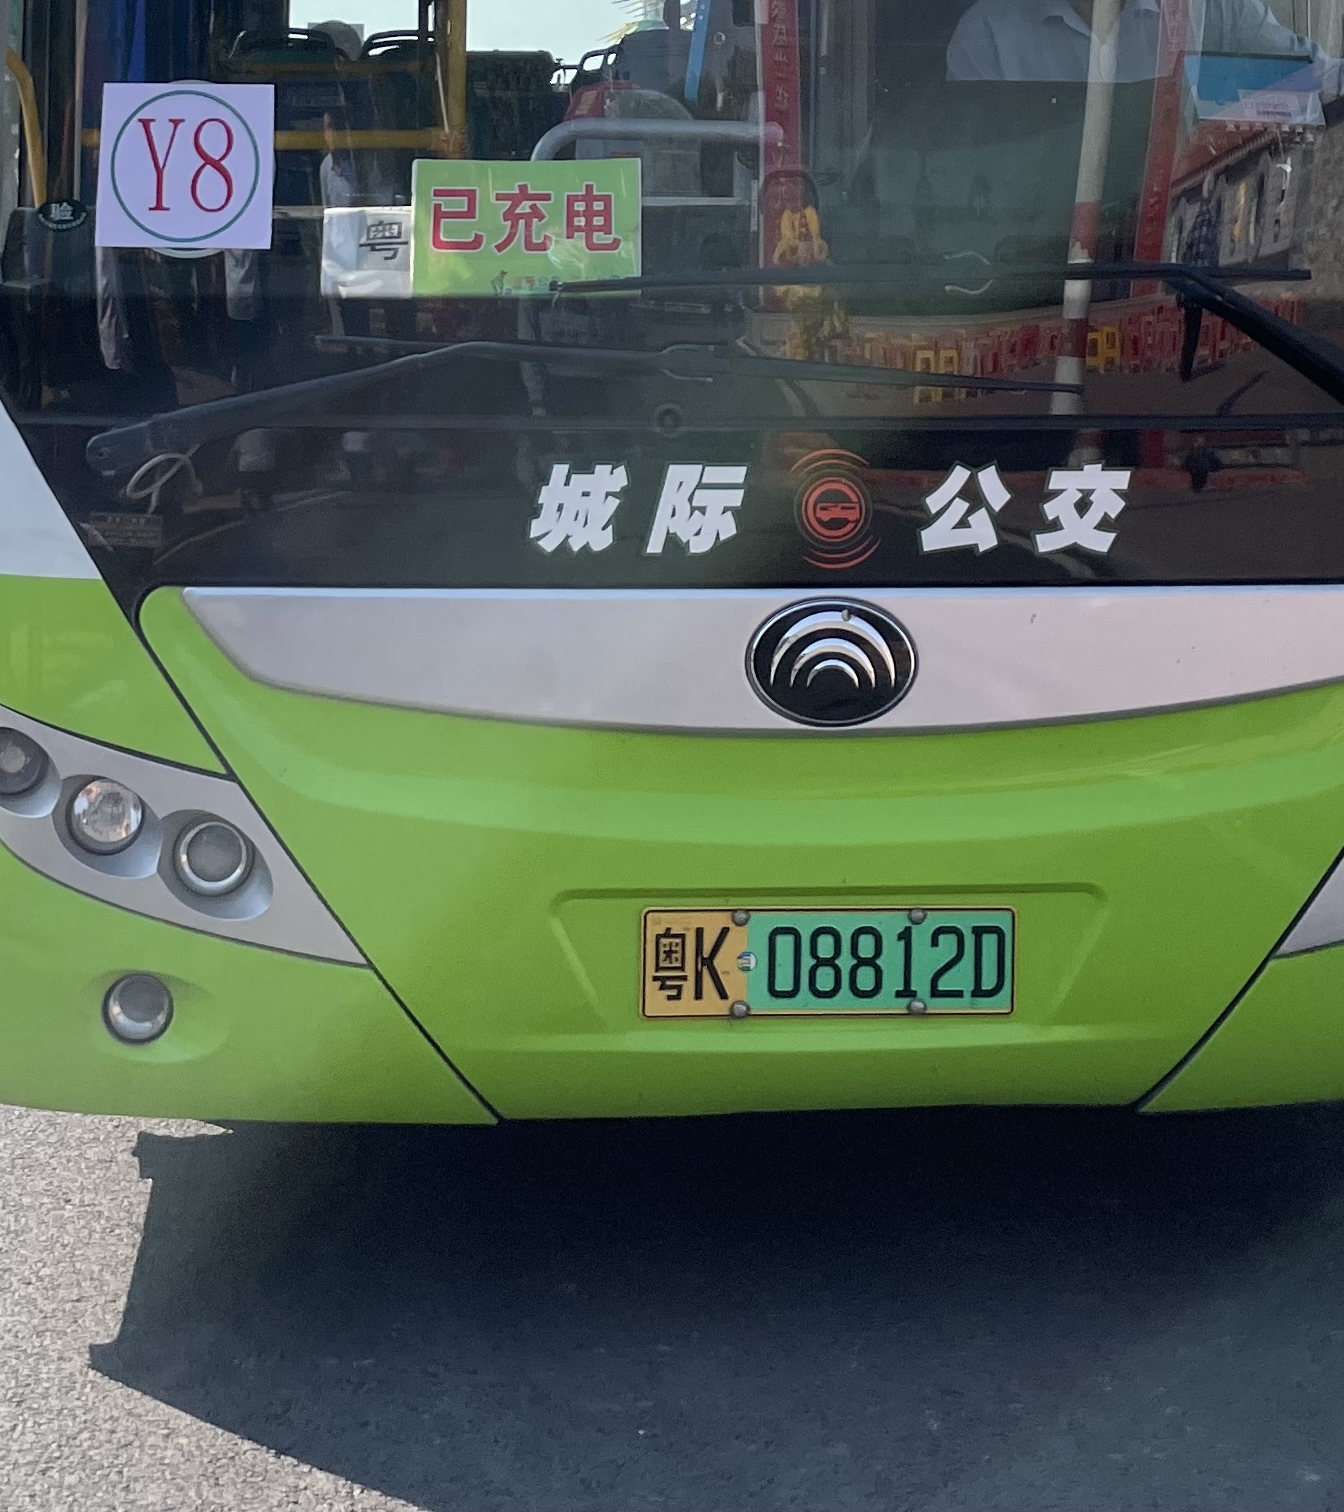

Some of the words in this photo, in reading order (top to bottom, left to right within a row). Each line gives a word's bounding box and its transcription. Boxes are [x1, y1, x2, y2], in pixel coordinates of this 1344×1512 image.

[137, 117, 235, 213] Y8
[358, 219, 409, 261] 粤
[430, 182, 623, 254] 已充电
[528, 464, 750, 555] 城际
[920, 462, 1132, 554] 公交
